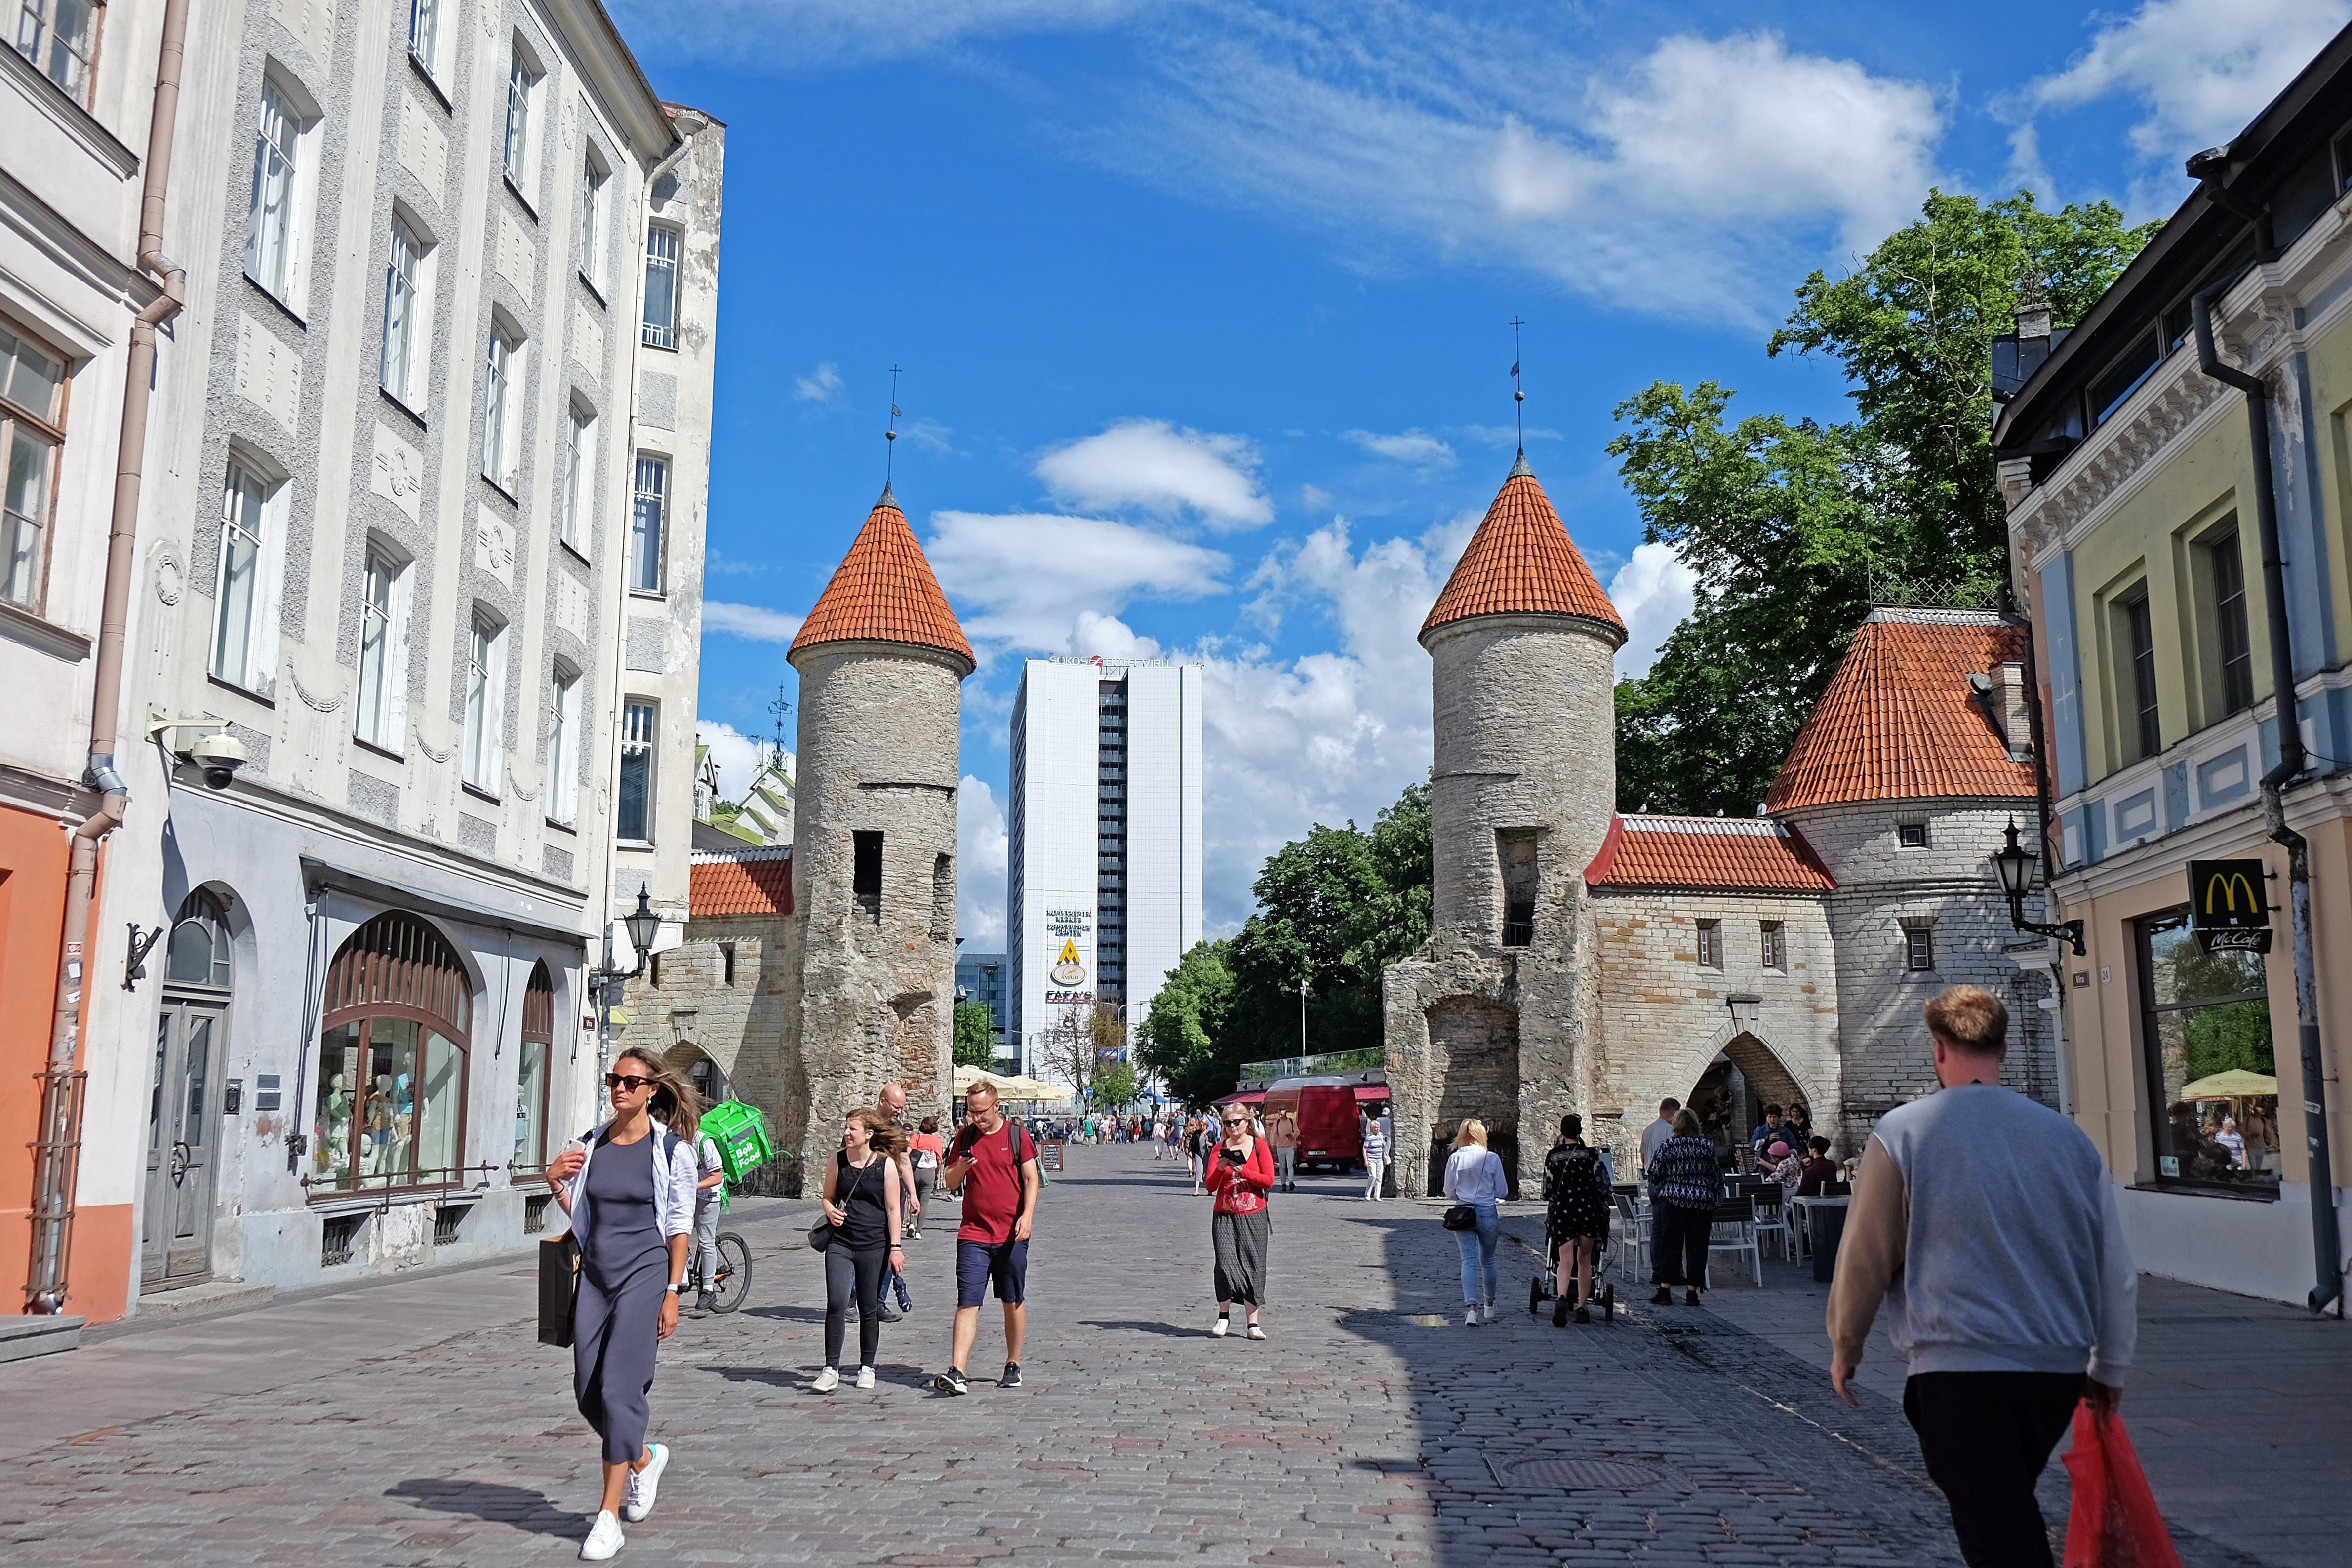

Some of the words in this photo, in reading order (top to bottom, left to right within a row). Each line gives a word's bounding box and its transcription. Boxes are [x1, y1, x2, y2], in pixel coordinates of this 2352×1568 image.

[1049, 656, 1087, 665] SOKOS
[1106, 658, 1141, 667] HOTEL
[2210, 931, 2261, 950] McCafé
[2102, 970, 2108, 980] 24
[1047, 991, 1092, 999] FAFA'S
[736, 1142, 753, 1158] Bolt
[738, 1149, 760, 1168] Food
